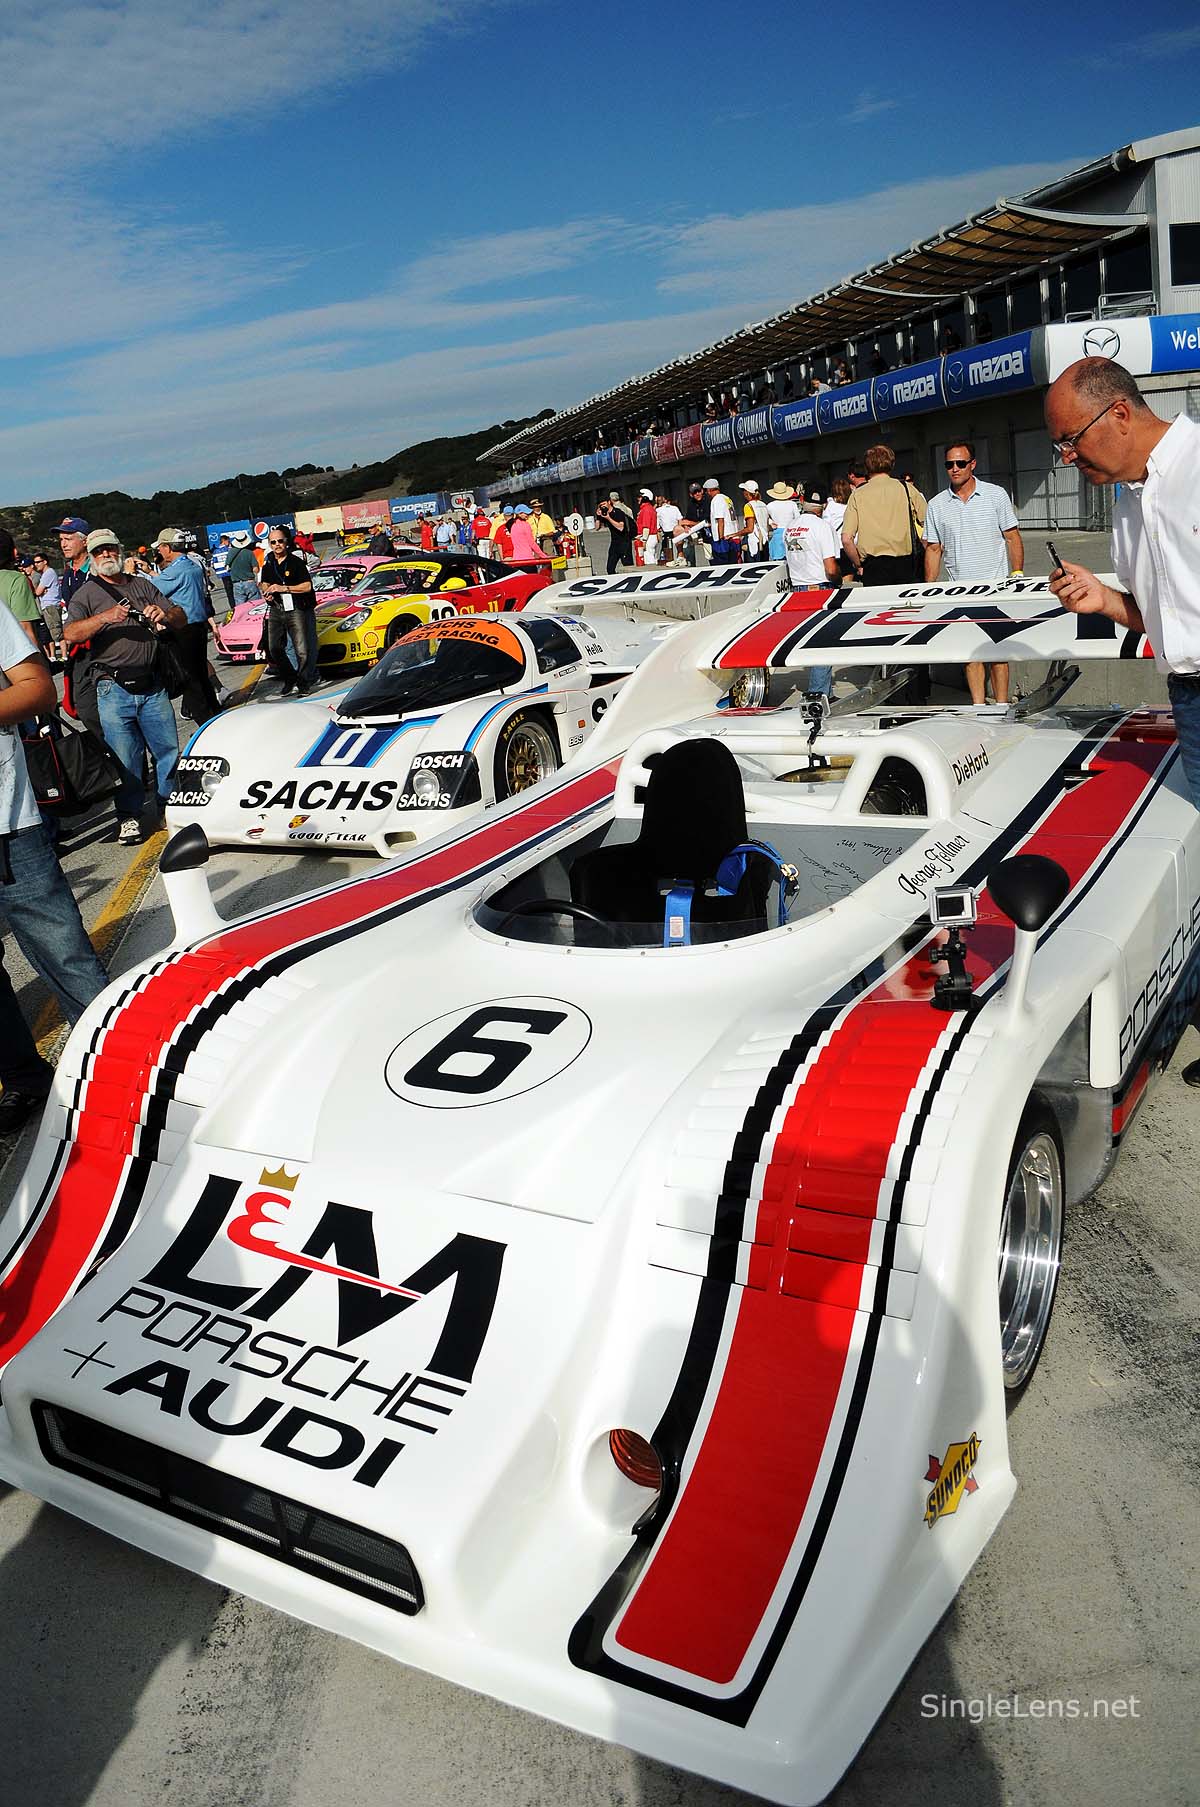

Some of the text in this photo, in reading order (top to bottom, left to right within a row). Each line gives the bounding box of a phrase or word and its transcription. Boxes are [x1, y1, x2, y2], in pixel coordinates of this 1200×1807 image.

[968, 349, 1025, 386] mazda
[892, 374, 937, 404] mazda
[833, 393, 868, 420] mazda
[743, 411, 768, 436] YAMAHA
[784, 409, 814, 432] mazda
[710, 422, 731, 444] YAMAHA
[742, 434, 769, 446] RACING
[709, 443, 732, 454] RACING
[392, 501, 436, 513] COOPER
[573, 518, 579, 531] 8
[566, 564, 780, 597] SACHS
[776, 578, 793, 594] SACH
[898, 578, 1053, 598] GOODYE
[422, 621, 477, 632] SACHS
[350, 641, 361, 652] B1
[437, 630, 500, 646] RACING
[350, 650, 377, 658] DUNLO
[584, 643, 604, 656] Hella
[320, 728, 377, 766] 0
[569, 734, 584, 747] BBS
[177, 758, 222, 772] BOSCH
[411, 754, 464, 770] BOSCH
[952, 743, 989, 786] DieHard
[168, 791, 211, 806] SACHS
[240, 780, 398, 811] SACHS
[399, 792, 451, 808] SACHS
[898, 834, 970, 900] George Follmer
[1119, 895, 1200, 1077] PORSCHE
[404, 1006, 569, 1095] 6
[97, 1287, 467, 1435] PORSCHE
[102, 1359, 406, 1488] AUDI
[929, 1435, 977, 1524] SUNOCO
